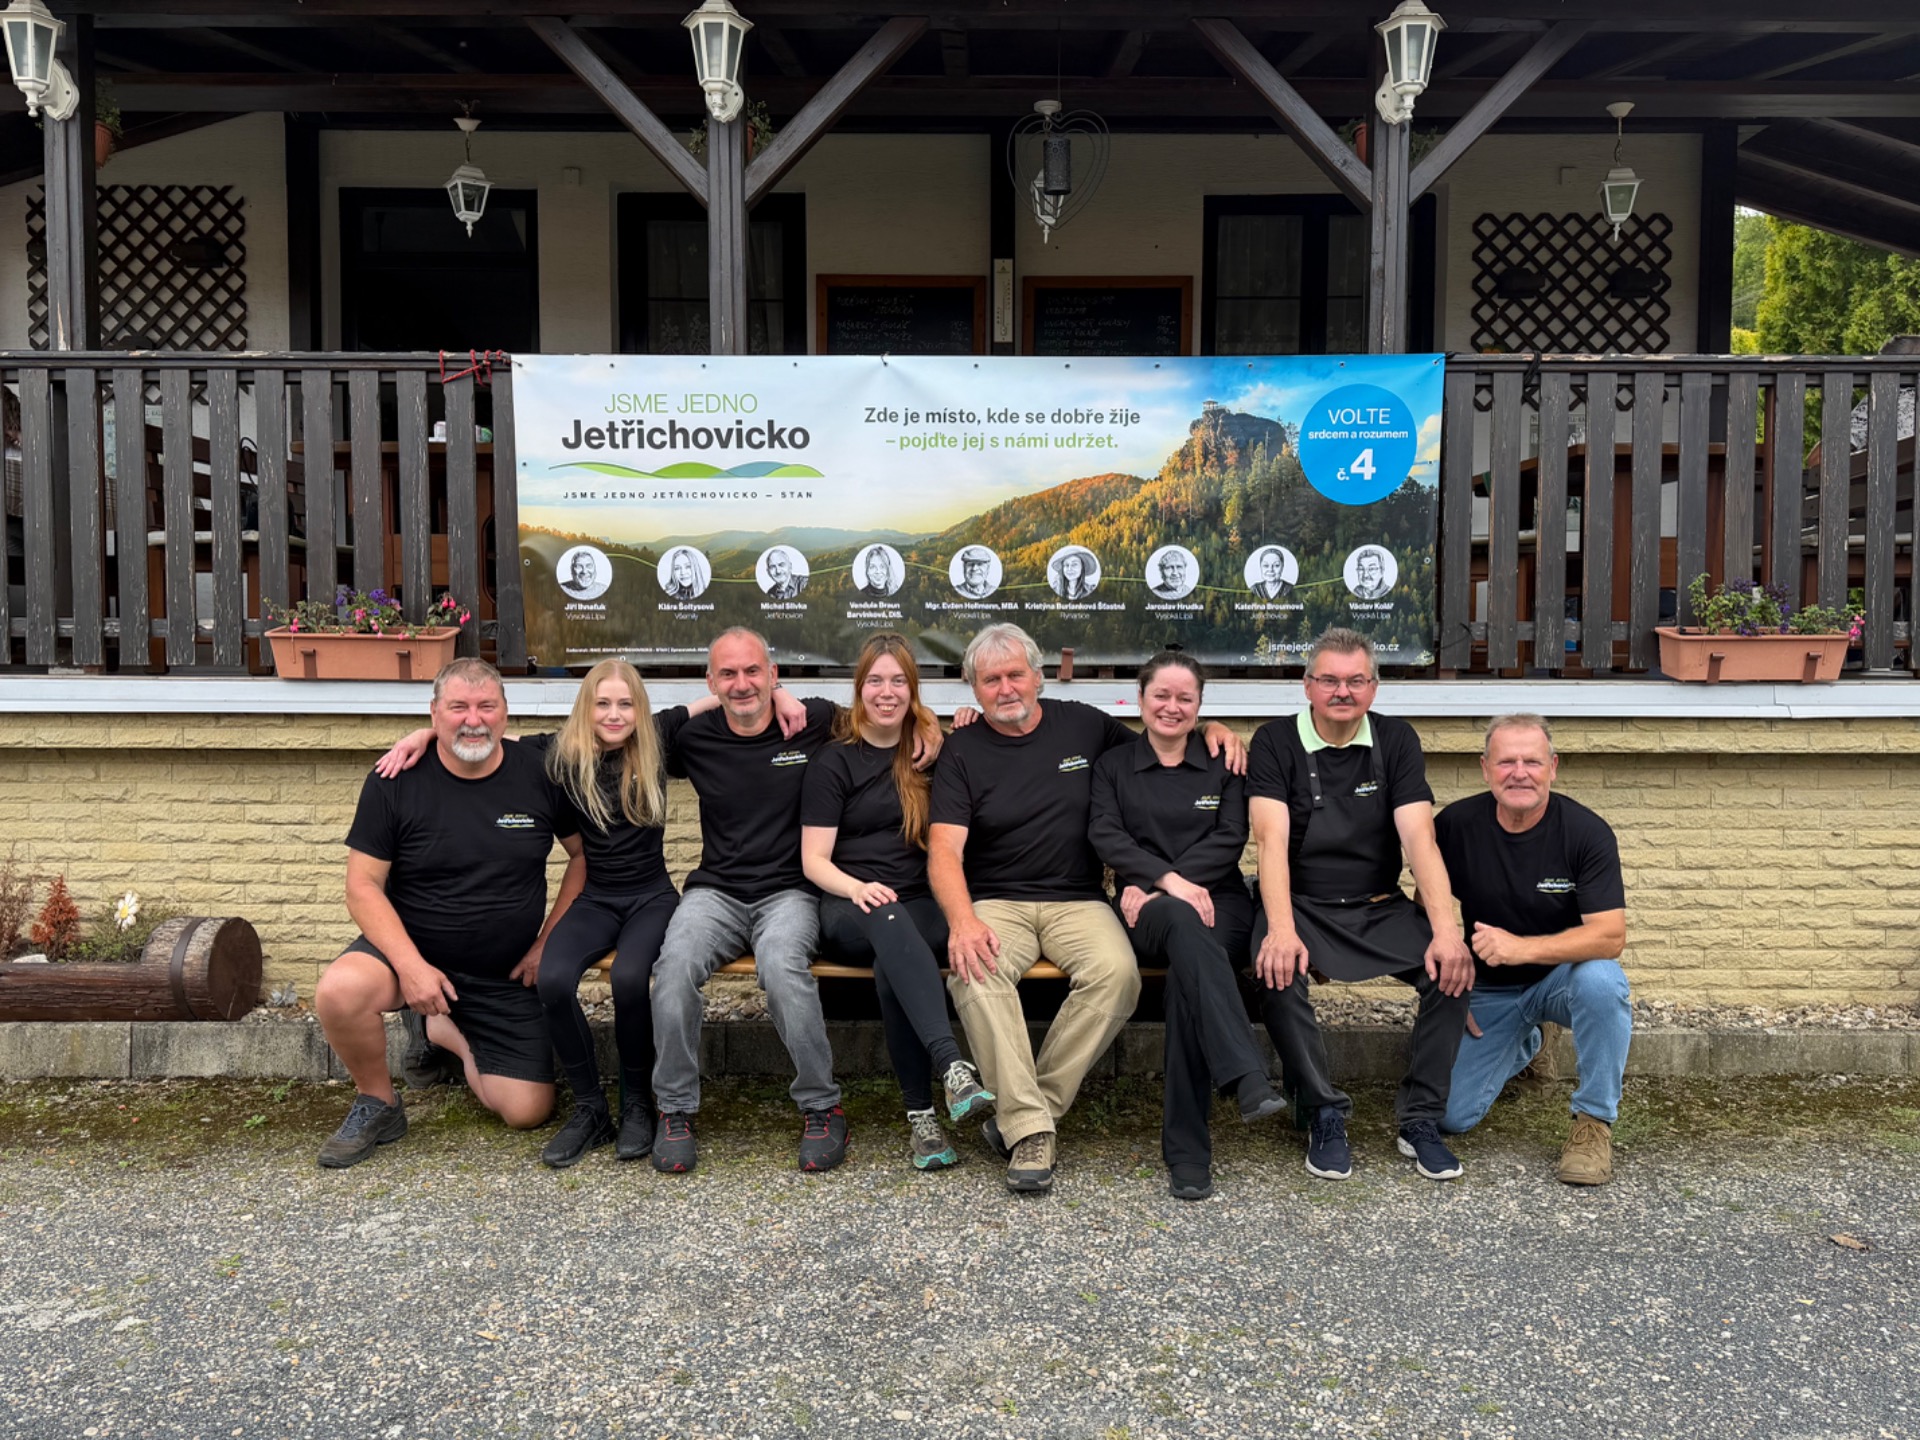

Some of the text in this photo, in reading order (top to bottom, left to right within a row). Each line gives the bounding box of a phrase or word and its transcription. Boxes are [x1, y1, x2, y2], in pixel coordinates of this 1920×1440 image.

[604, 393, 758, 413] JSME JEDNO
[864, 407, 1141, 426] Zde je místo, kde se dobře žije
[1327, 408, 1391, 425] VOLTE
[562, 419, 810, 449] Jetřichovicko
[900, 432, 958, 450] pojďte
[962, 432, 985, 451] jej
[990, 436, 1000, 448] s
[1004, 432, 1049, 448] námi
[1054, 432, 1118, 448] udržet.
[1308, 429, 1409, 439] srdcem a rozumem
[563, 491, 597, 499] JSME
[603, 491, 646, 499] JEDNO
[652, 490, 758, 499] JETŘICHOVICKO
[781, 491, 813, 499] STAN
[1002, 602, 1019, 610] MBA
